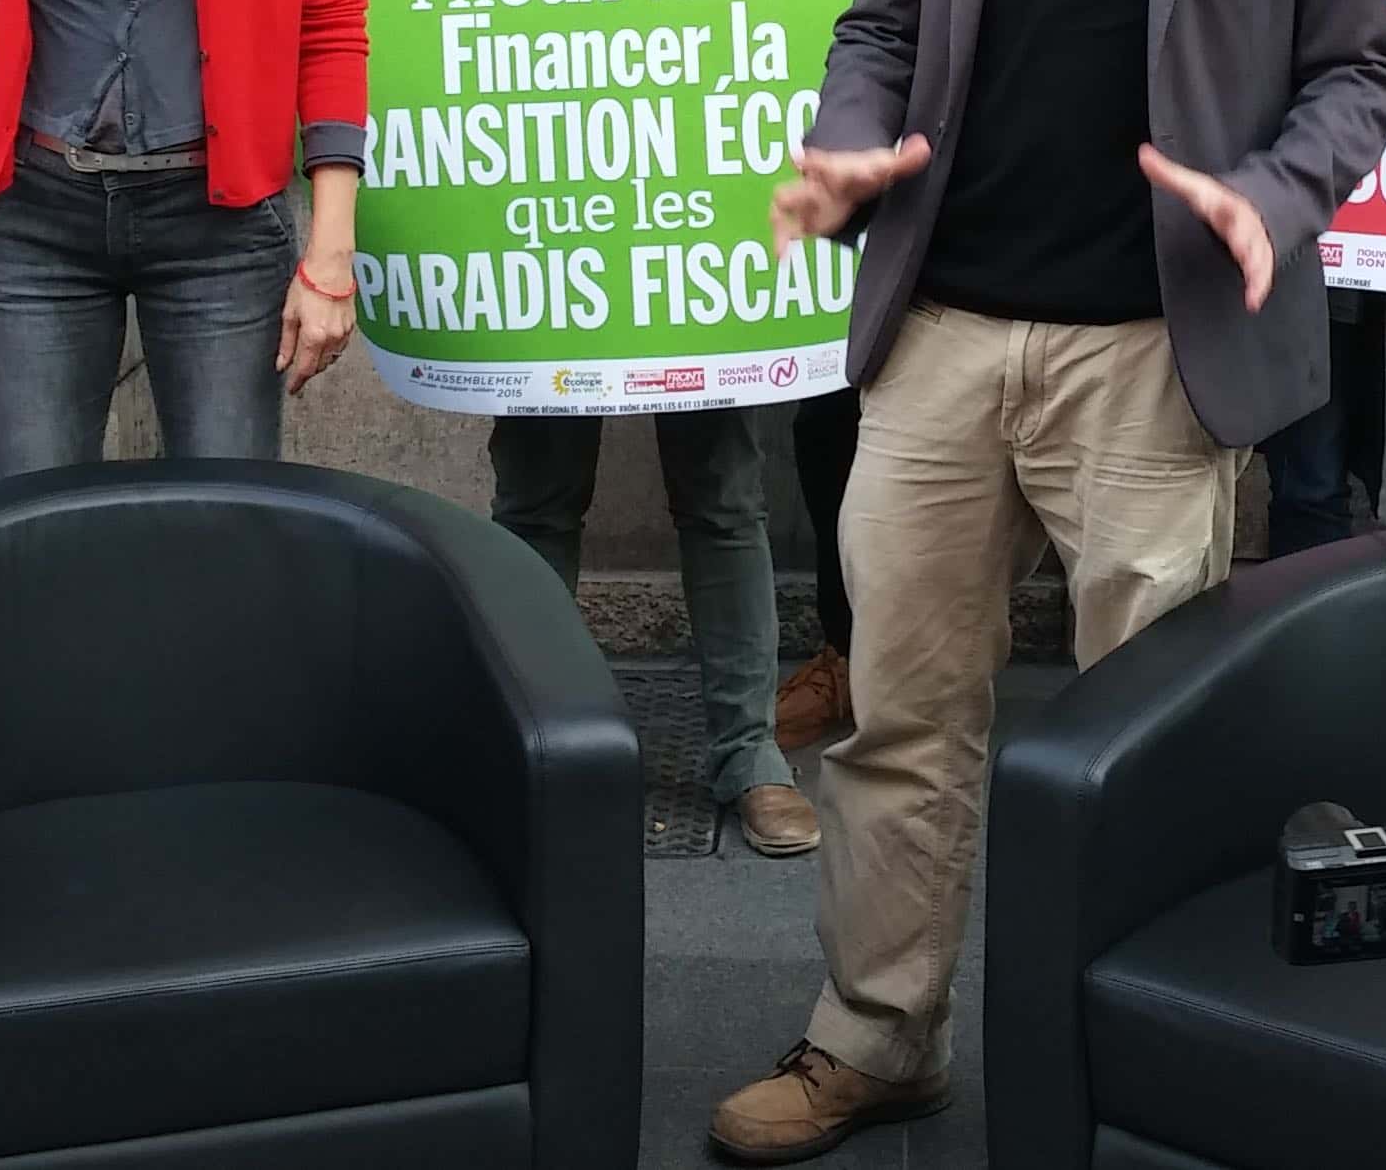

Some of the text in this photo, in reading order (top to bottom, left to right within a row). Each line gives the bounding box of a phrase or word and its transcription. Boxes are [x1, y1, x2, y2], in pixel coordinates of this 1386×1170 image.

[441, 1, 789, 95] Financer la
[506, 178, 715, 249] que les
[353, 248, 609, 331] PARADIS
[717, 364, 764, 376] nouvelle
[427, 372, 531, 386] RASSEMBLEMENT
[563, 375, 603, 387] écologie
[718, 375, 765, 387] DONNE
[496, 388, 523, 398] 2015
